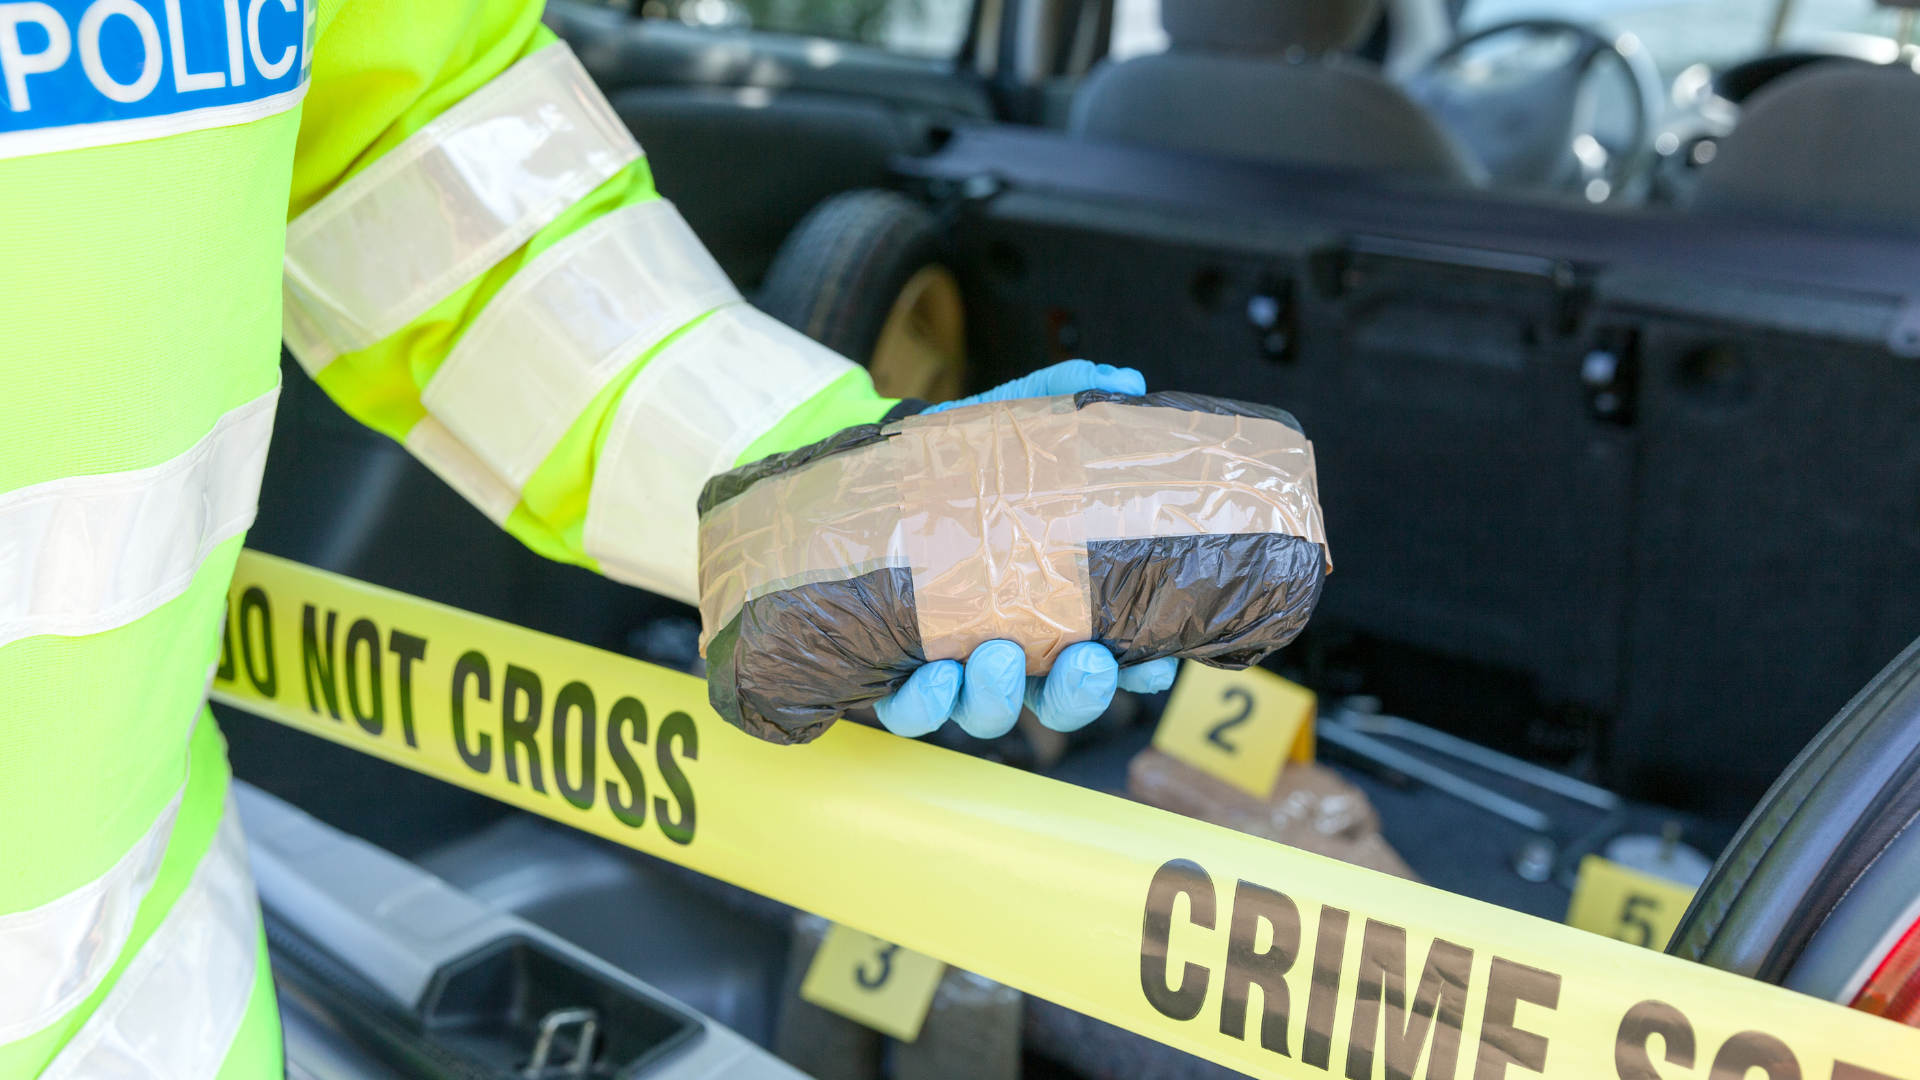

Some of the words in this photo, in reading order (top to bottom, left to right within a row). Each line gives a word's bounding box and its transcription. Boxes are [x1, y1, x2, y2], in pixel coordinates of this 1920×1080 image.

[302, 603, 428, 750] NOT
[451, 650, 699, 846] CROSS
[1206, 687, 1255, 753] 2
[1140, 857, 1562, 1080] CRIME
[1616, 894, 1660, 948] 5
